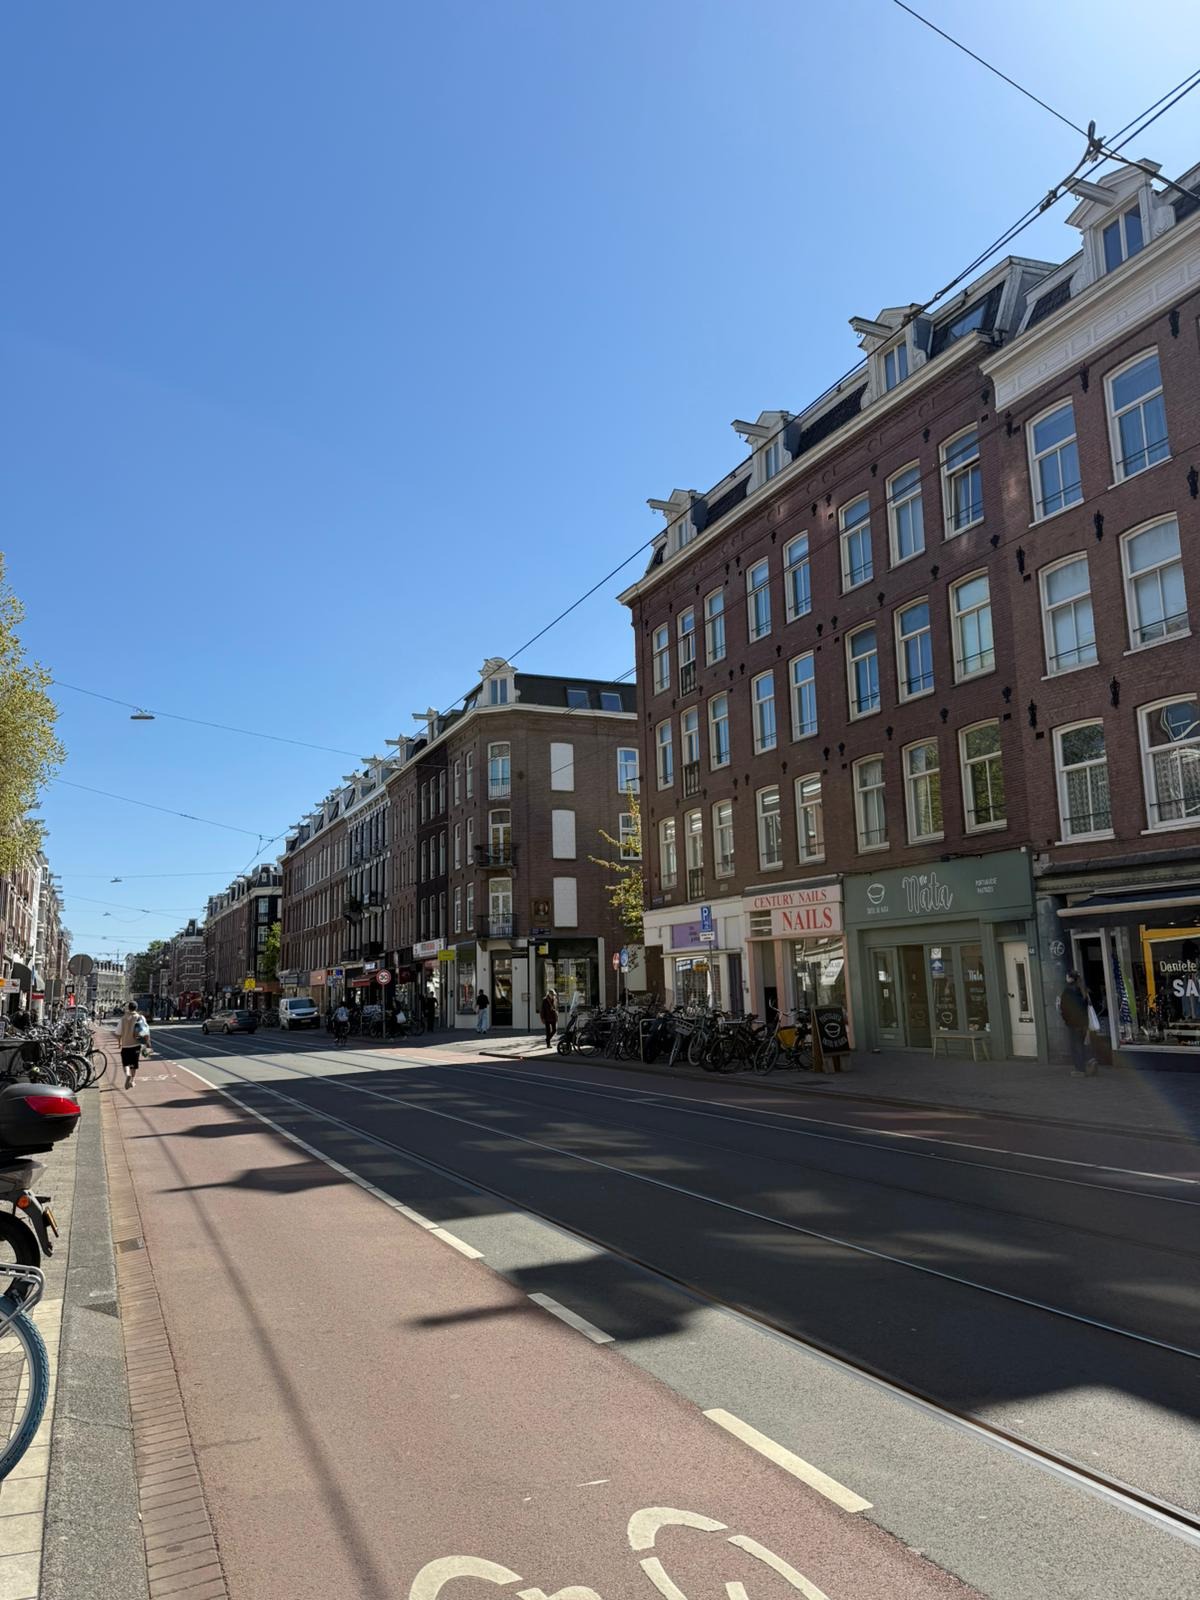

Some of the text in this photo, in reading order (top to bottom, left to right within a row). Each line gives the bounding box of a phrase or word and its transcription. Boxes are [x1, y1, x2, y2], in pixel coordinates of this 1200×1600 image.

[754, 889, 827, 908] CENTURY NAILS
[902, 872, 953, 913] Nata
[703, 908, 708, 920] P
[782, 907, 833, 931] NAILS
[1172, 978, 1200, 997] SA
